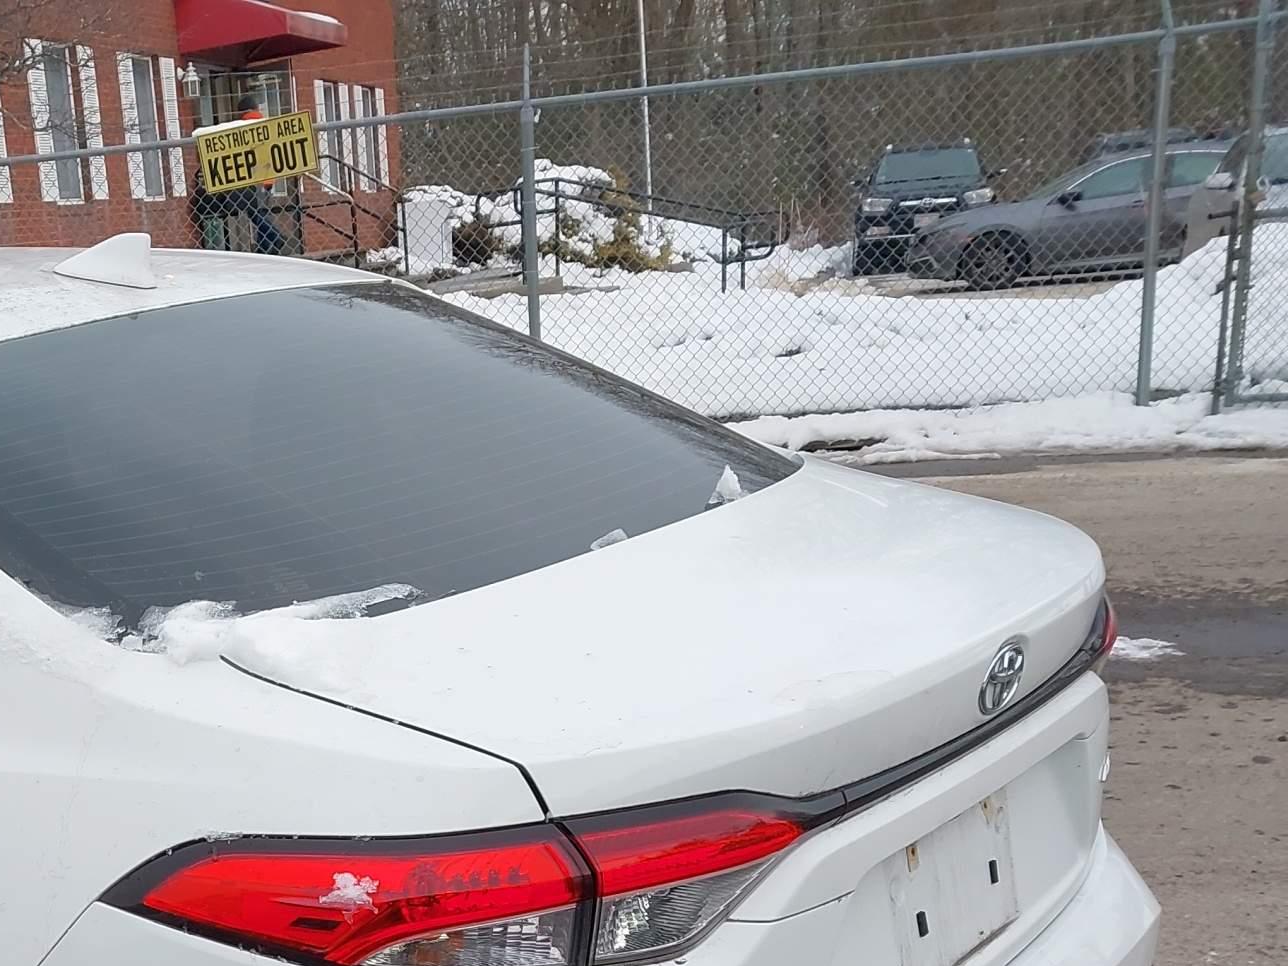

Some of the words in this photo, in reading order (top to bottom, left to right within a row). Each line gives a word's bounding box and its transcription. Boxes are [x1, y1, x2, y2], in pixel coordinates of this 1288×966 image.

[205, 125, 269, 153] RESTRICTED
[277, 117, 305, 138] AREA
[208, 150, 257, 187] KEEP
[270, 138, 308, 173] OUT
